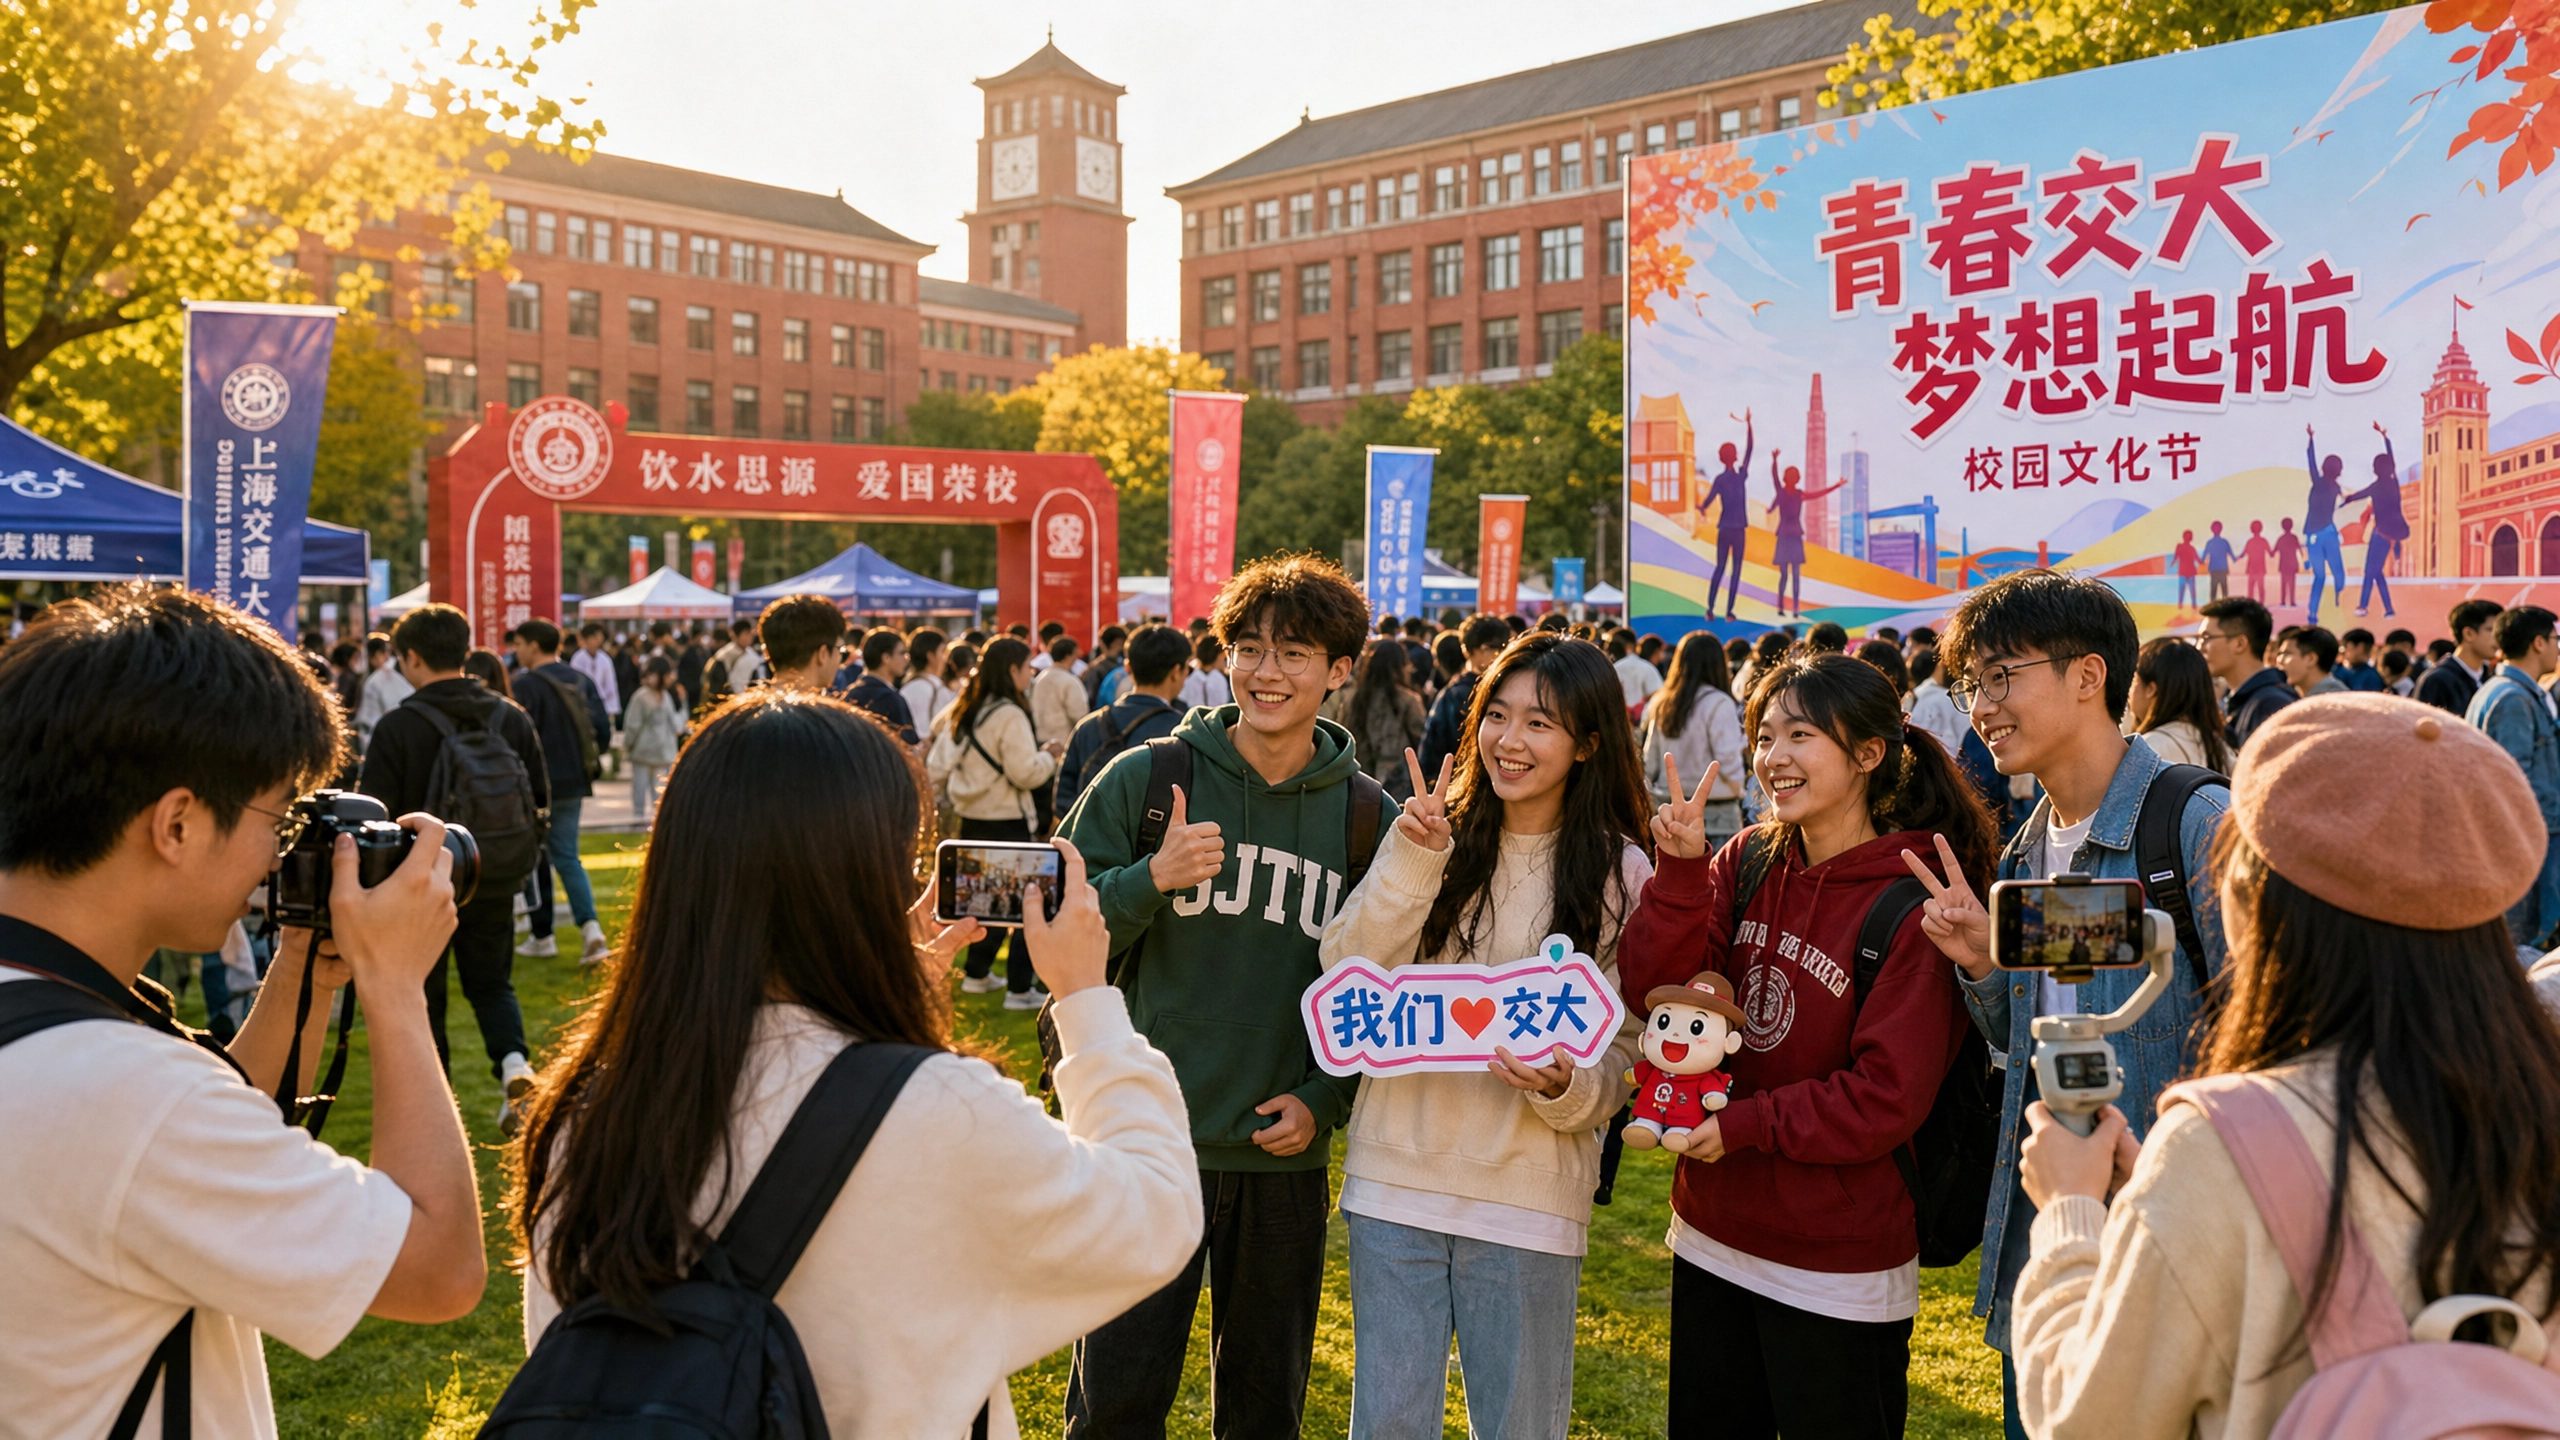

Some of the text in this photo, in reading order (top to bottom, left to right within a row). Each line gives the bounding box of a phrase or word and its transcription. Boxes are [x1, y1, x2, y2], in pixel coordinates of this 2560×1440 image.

[1820, 138, 2274, 313] 青春交大
[1893, 258, 2388, 441] 梦想起航
[638, 448, 1019, 504] 饮水思源 爱国荣校
[1964, 432, 2202, 492] 校园文化节
[1331, 982, 1588, 1048] 我们 交大
